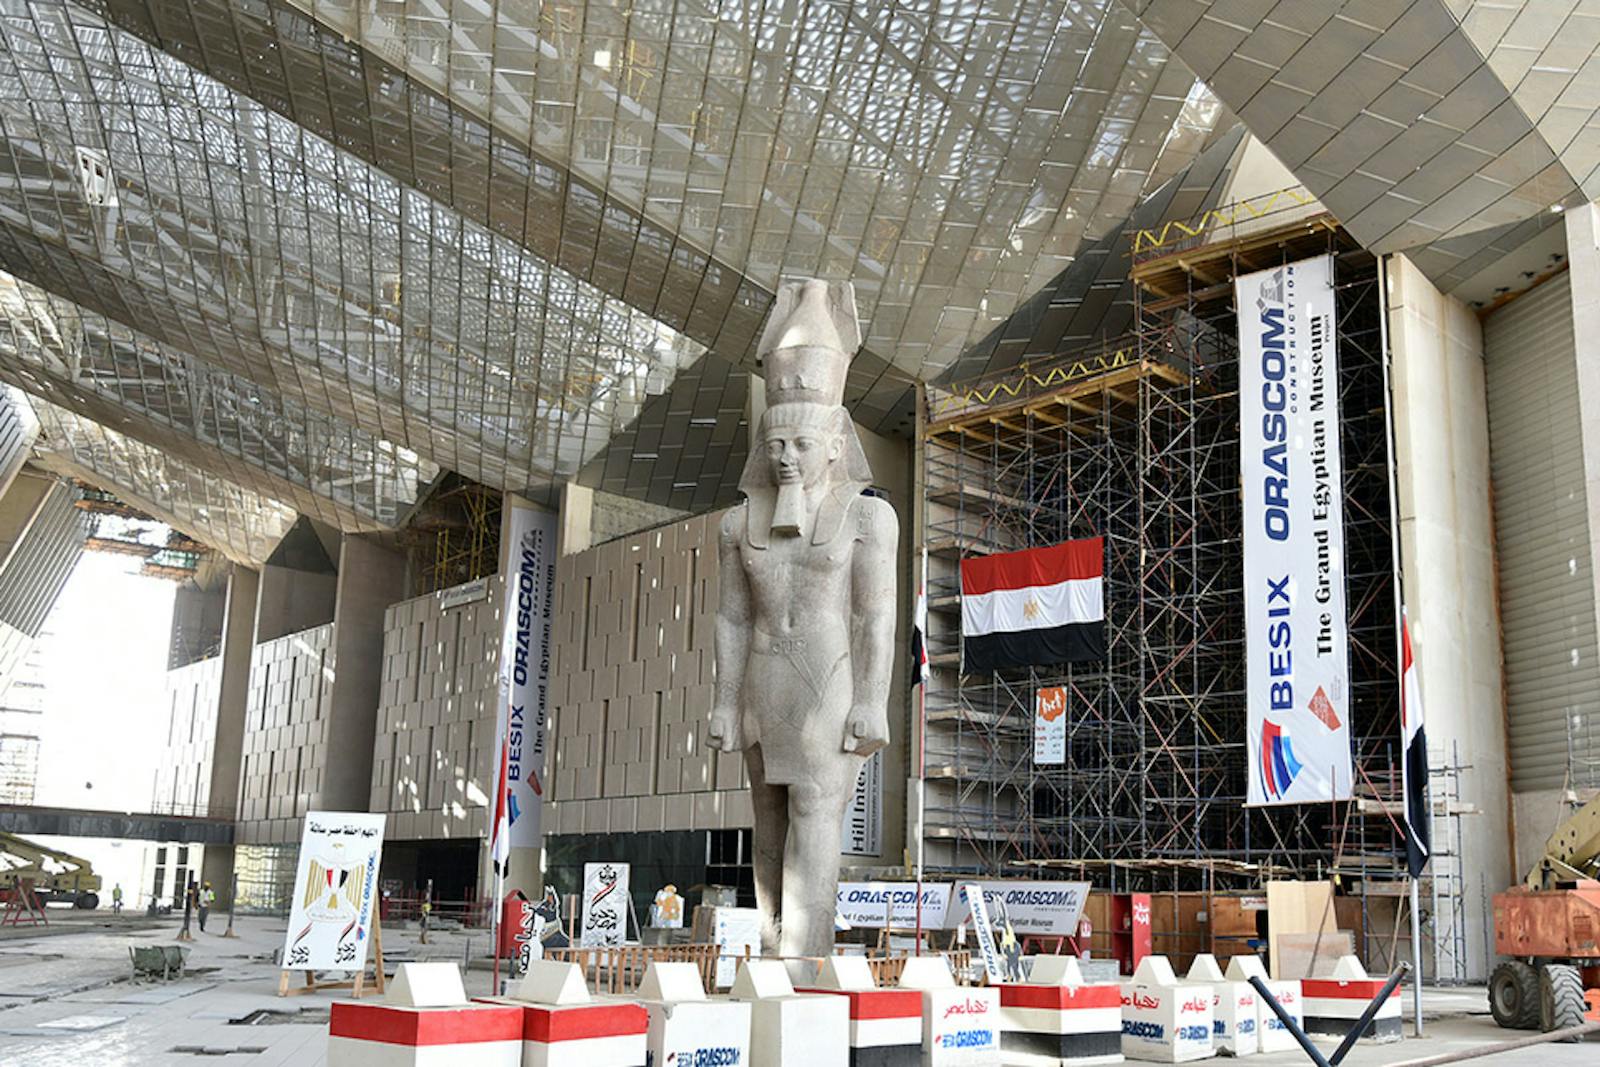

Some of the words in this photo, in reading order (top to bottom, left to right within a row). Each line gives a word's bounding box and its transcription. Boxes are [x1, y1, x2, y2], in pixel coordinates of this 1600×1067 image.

[1286, 266, 1298, 414] CONSTRUCTION
[1309, 315, 1325, 412] Museum
[1260, 307, 1290, 541] ORASCOM
[1310, 420, 1331, 522] Egyptian
[1314, 530, 1331, 604] Grand
[513, 552, 536, 687] ORASCOM
[537, 685, 546, 725] Grand
[542, 564, 554, 618] Museum
[1267, 574, 1293, 711] BESIX
[1316, 613, 1332, 658] The
[508, 705, 525, 781] BESIX
[852, 818, 865, 852] Hill
[847, 890, 929, 905] ORASCOM
[1006, 890, 1069, 906] ORASCOM
